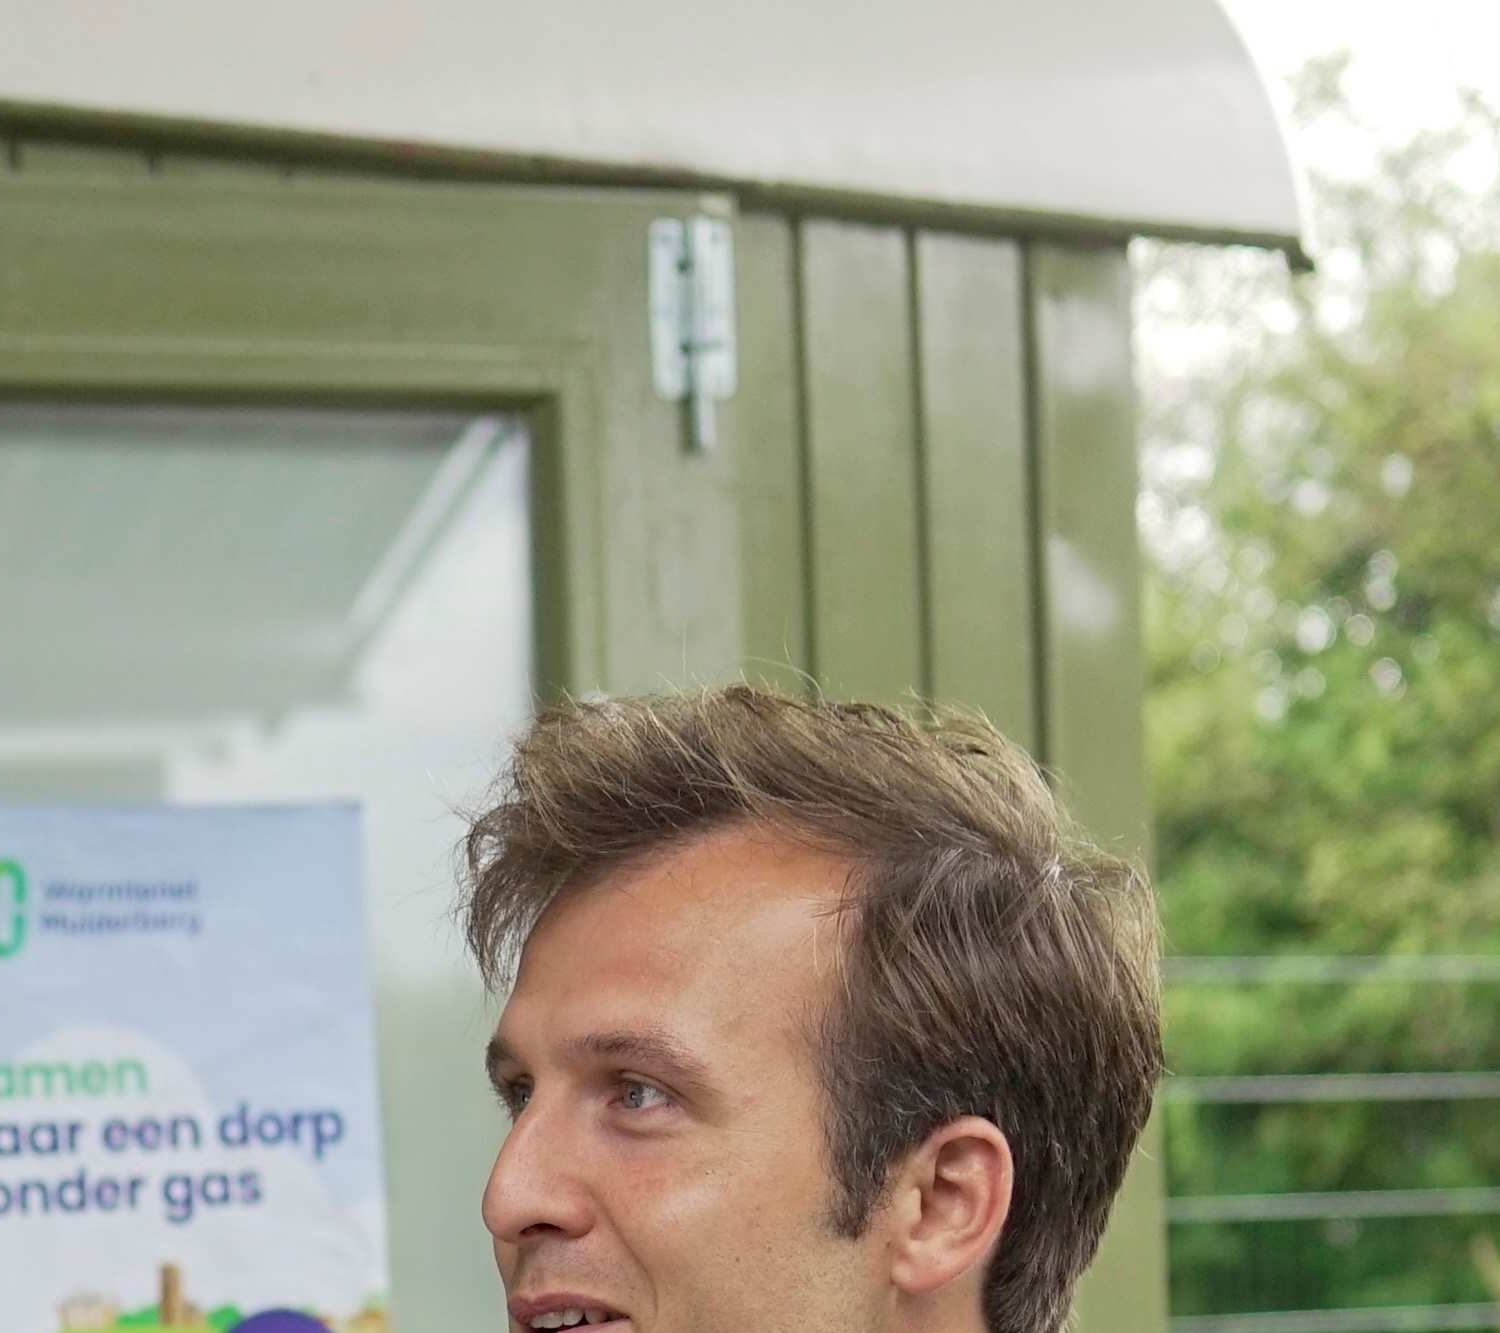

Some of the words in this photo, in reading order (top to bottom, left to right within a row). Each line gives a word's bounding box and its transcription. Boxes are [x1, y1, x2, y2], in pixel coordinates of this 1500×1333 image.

[103, 1115, 201, 1151] een
[217, 1101, 345, 1161] dorp
[163, 1172, 263, 1225] gas
